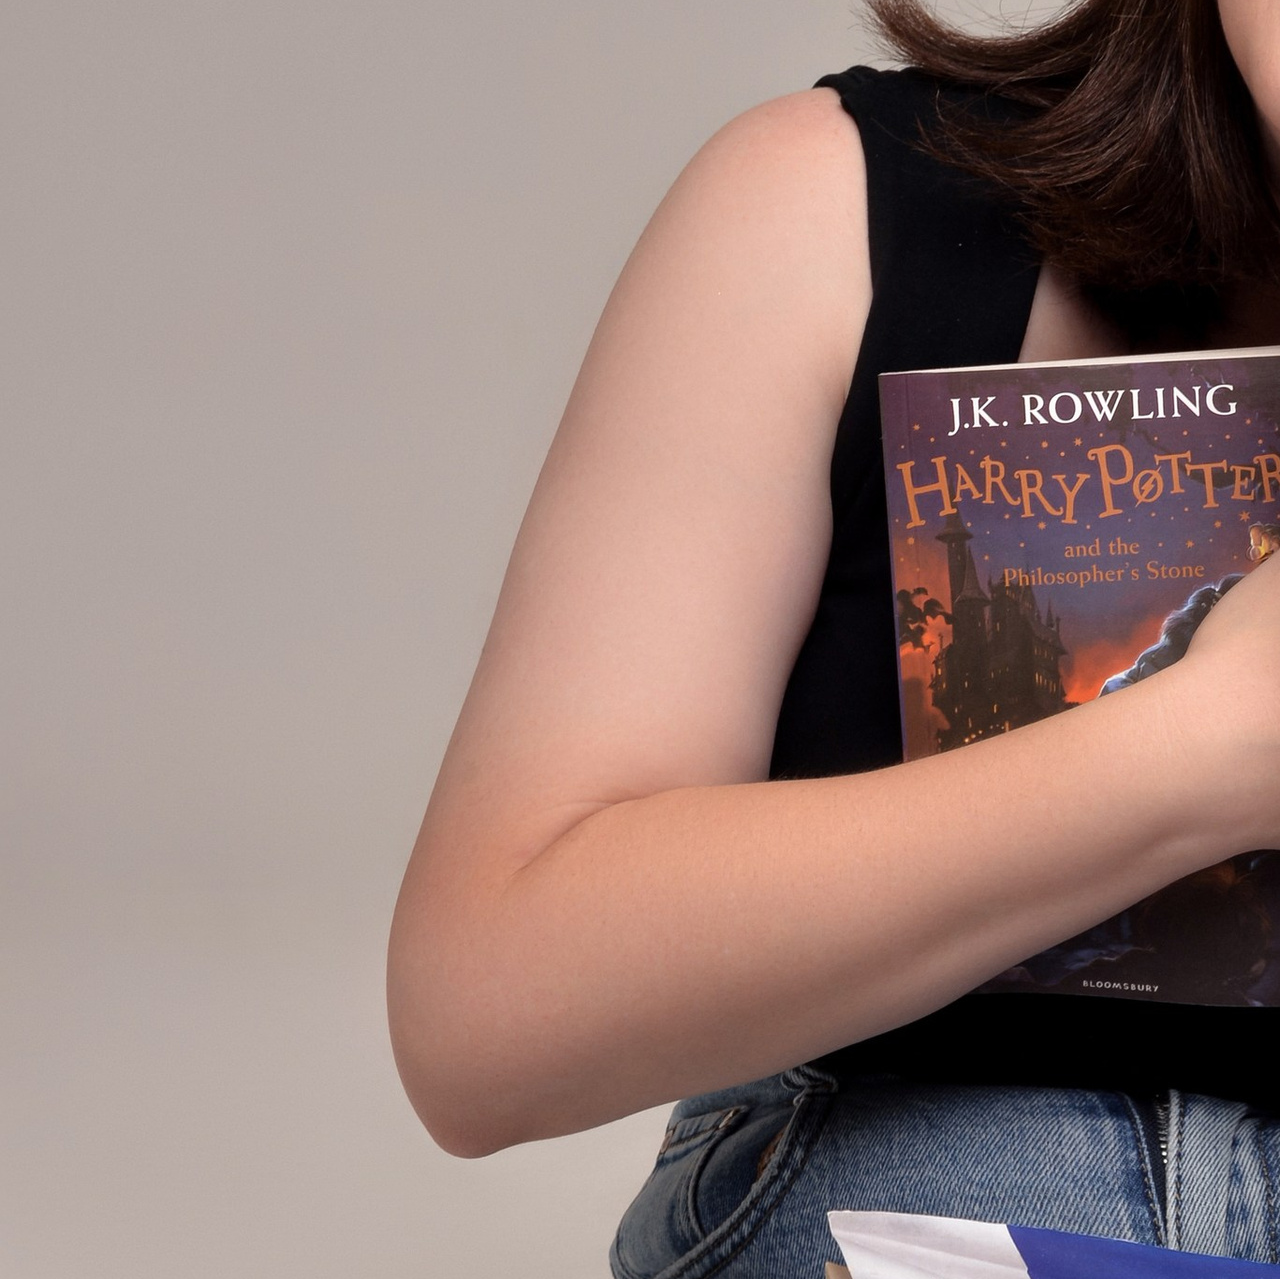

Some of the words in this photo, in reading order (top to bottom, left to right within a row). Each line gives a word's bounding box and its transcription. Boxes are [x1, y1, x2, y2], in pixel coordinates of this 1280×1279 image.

[948, 395, 1008, 436] J.K.
[1023, 384, 1238, 425] ROWLING
[896, 454, 1091, 529] HARRY
[1064, 538, 1100, 559] and
[1109, 537, 1140, 556] the
[1003, 562, 1140, 588] Philosopher's
[1146, 560, 1205, 580] Stone
[1082, 979, 1159, 993] BLOOMSBURY
